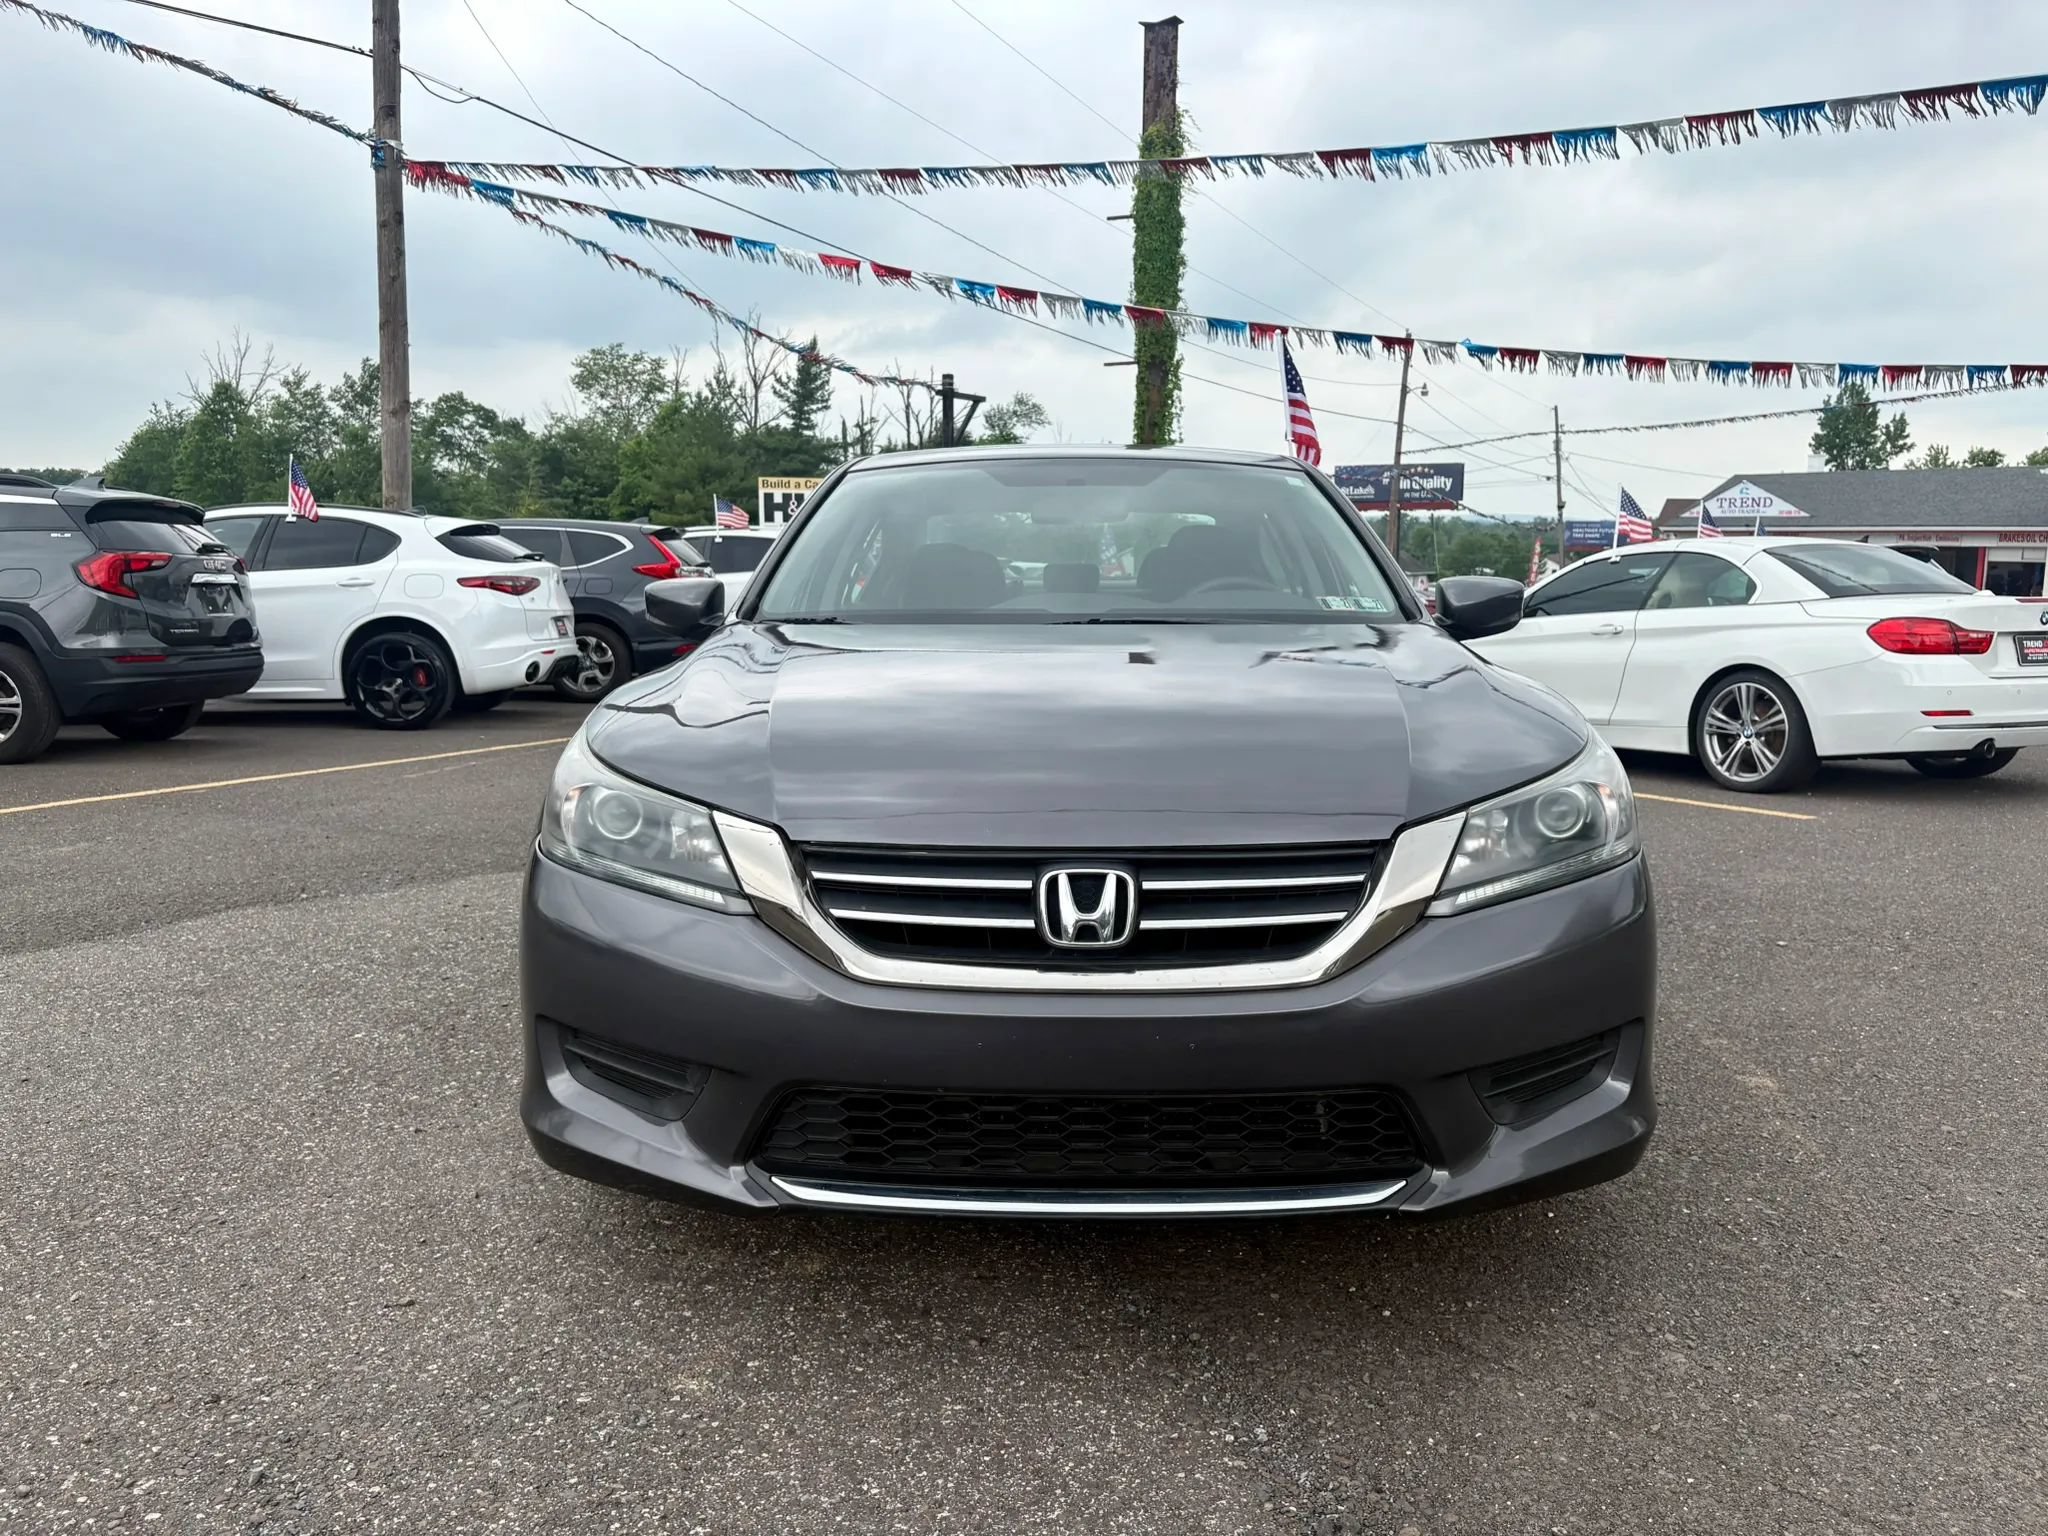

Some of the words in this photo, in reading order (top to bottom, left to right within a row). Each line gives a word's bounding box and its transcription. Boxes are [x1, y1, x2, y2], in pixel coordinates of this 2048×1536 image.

[761, 479, 791, 489] Build
[794, 481, 801, 489] a
[1411, 475, 1453, 492] Quality
[1716, 497, 1773, 509] TREND
[1998, 533, 2025, 543] BRAKES
[2026, 533, 2037, 543] OIL
[2022, 640, 2043, 648] TREND
